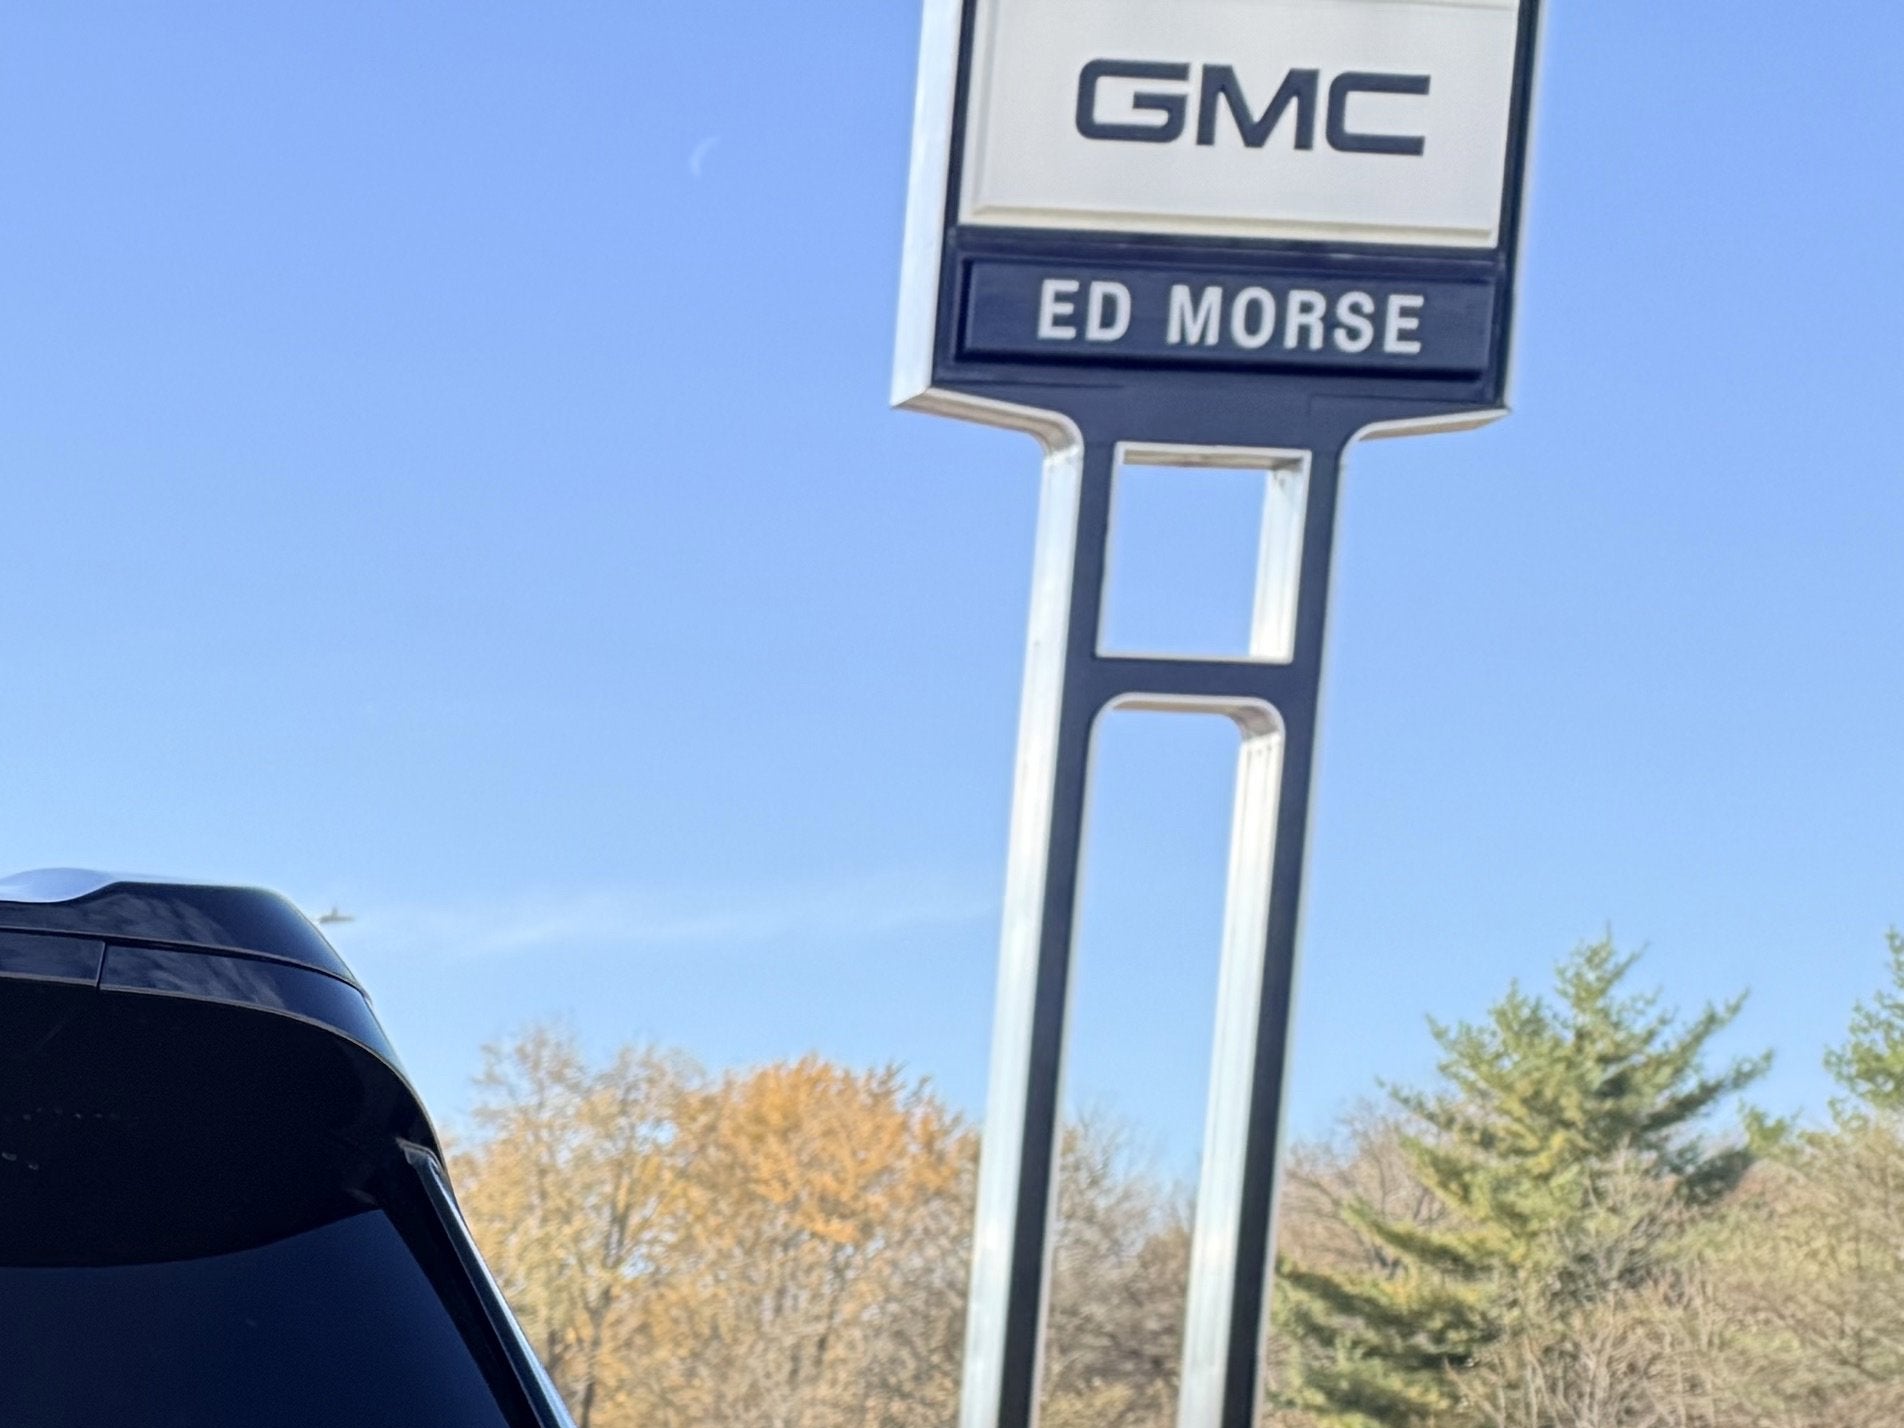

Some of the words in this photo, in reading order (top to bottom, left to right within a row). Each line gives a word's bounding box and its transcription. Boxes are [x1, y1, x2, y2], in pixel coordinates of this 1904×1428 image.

[1075, 58, 1431, 156] GMC
[1037, 279, 1131, 342] ED
[1166, 284, 1424, 356] MORSE
